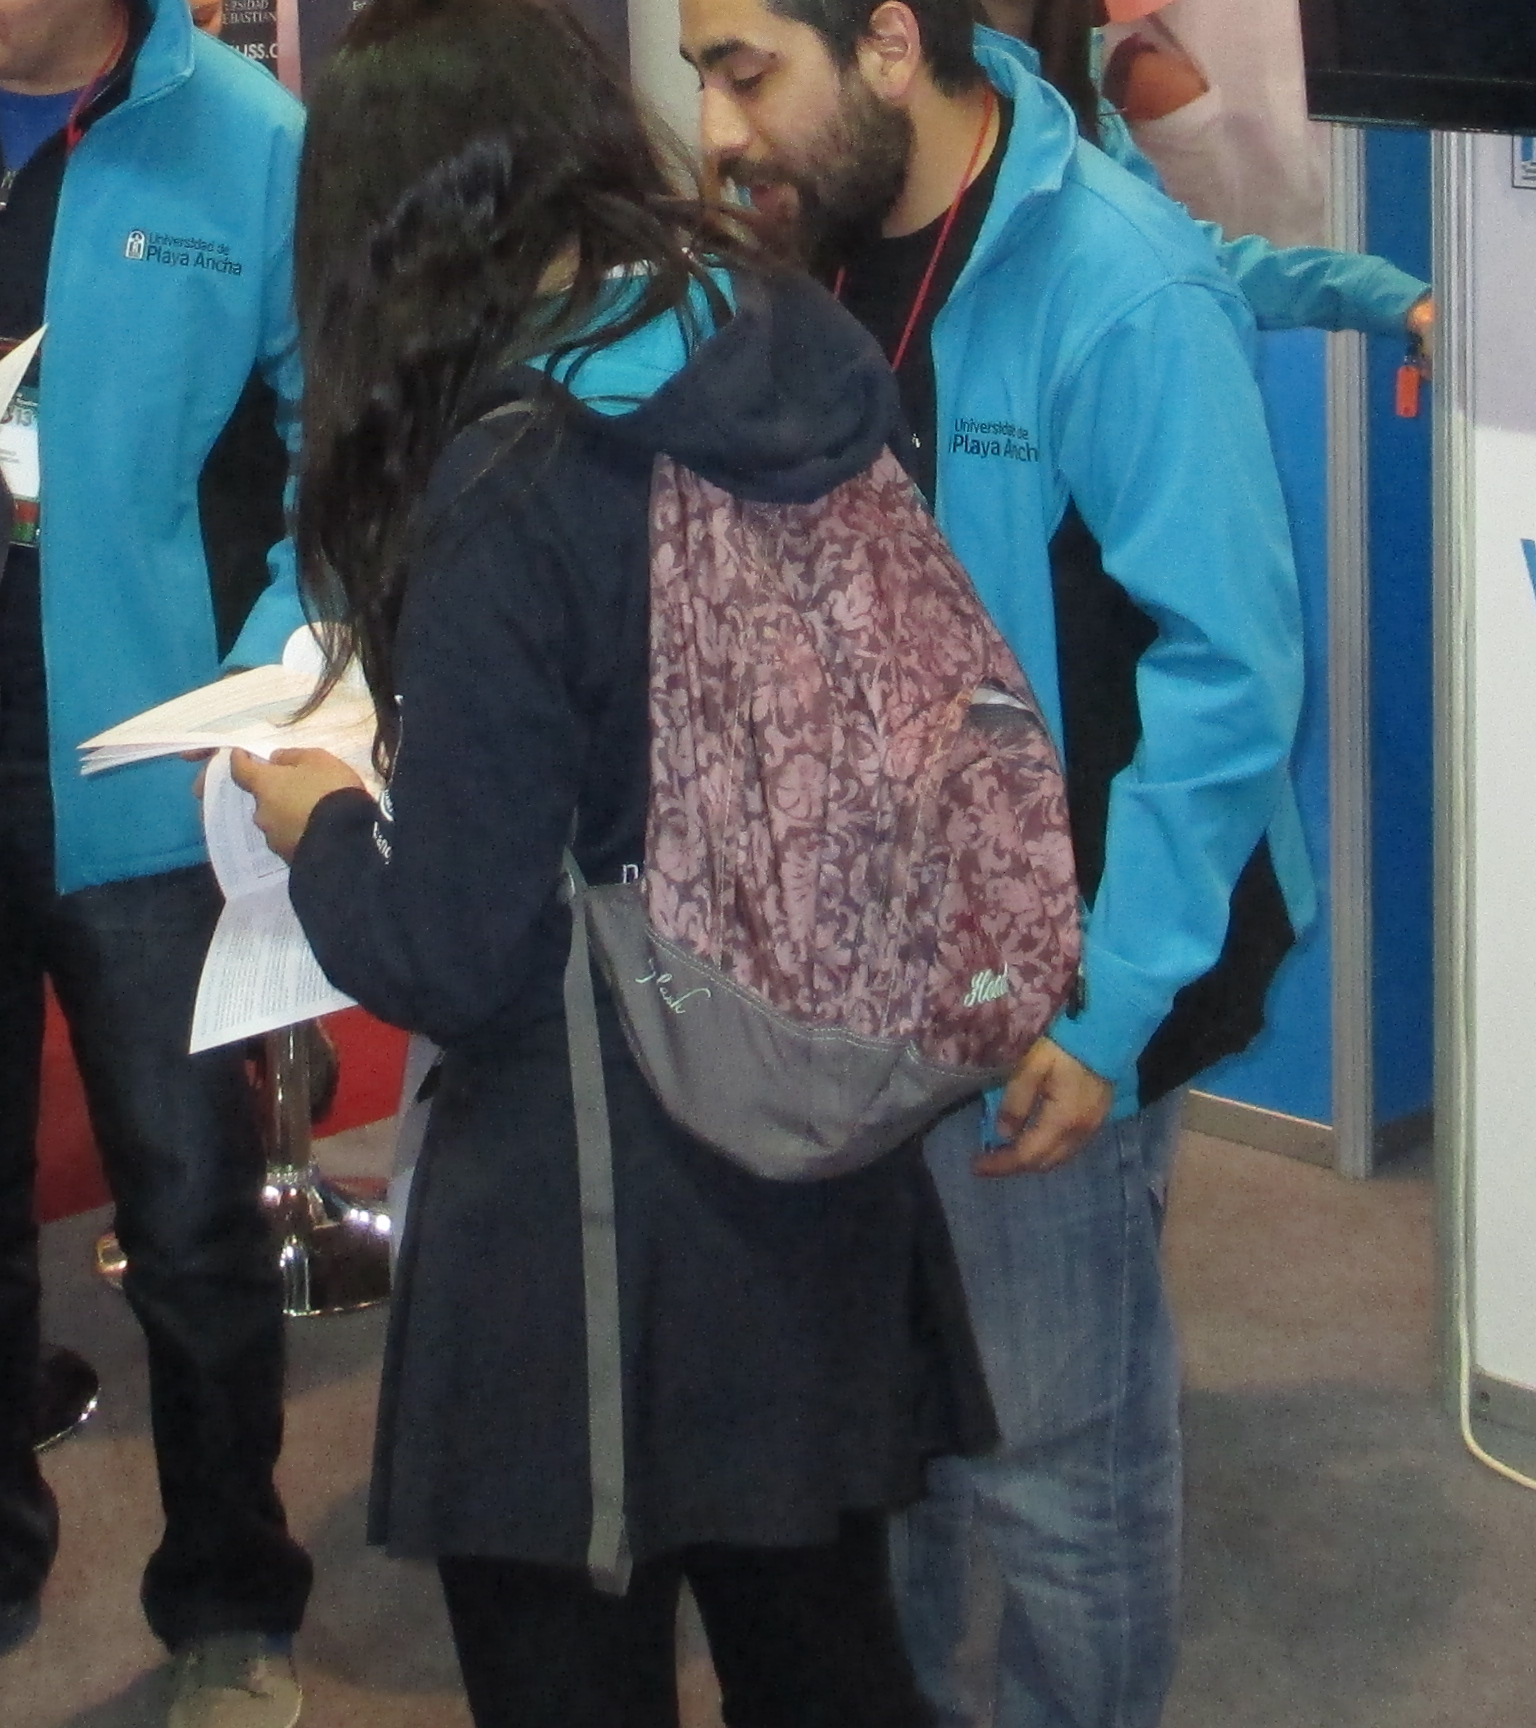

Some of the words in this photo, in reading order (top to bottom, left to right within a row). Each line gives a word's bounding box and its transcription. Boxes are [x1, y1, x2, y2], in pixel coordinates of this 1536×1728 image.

[146, 245, 190, 267] Playa
[193, 252, 243, 276] Ancha
[953, 434, 1001, 459] Playa
[1003, 439, 1039, 463] Anch
